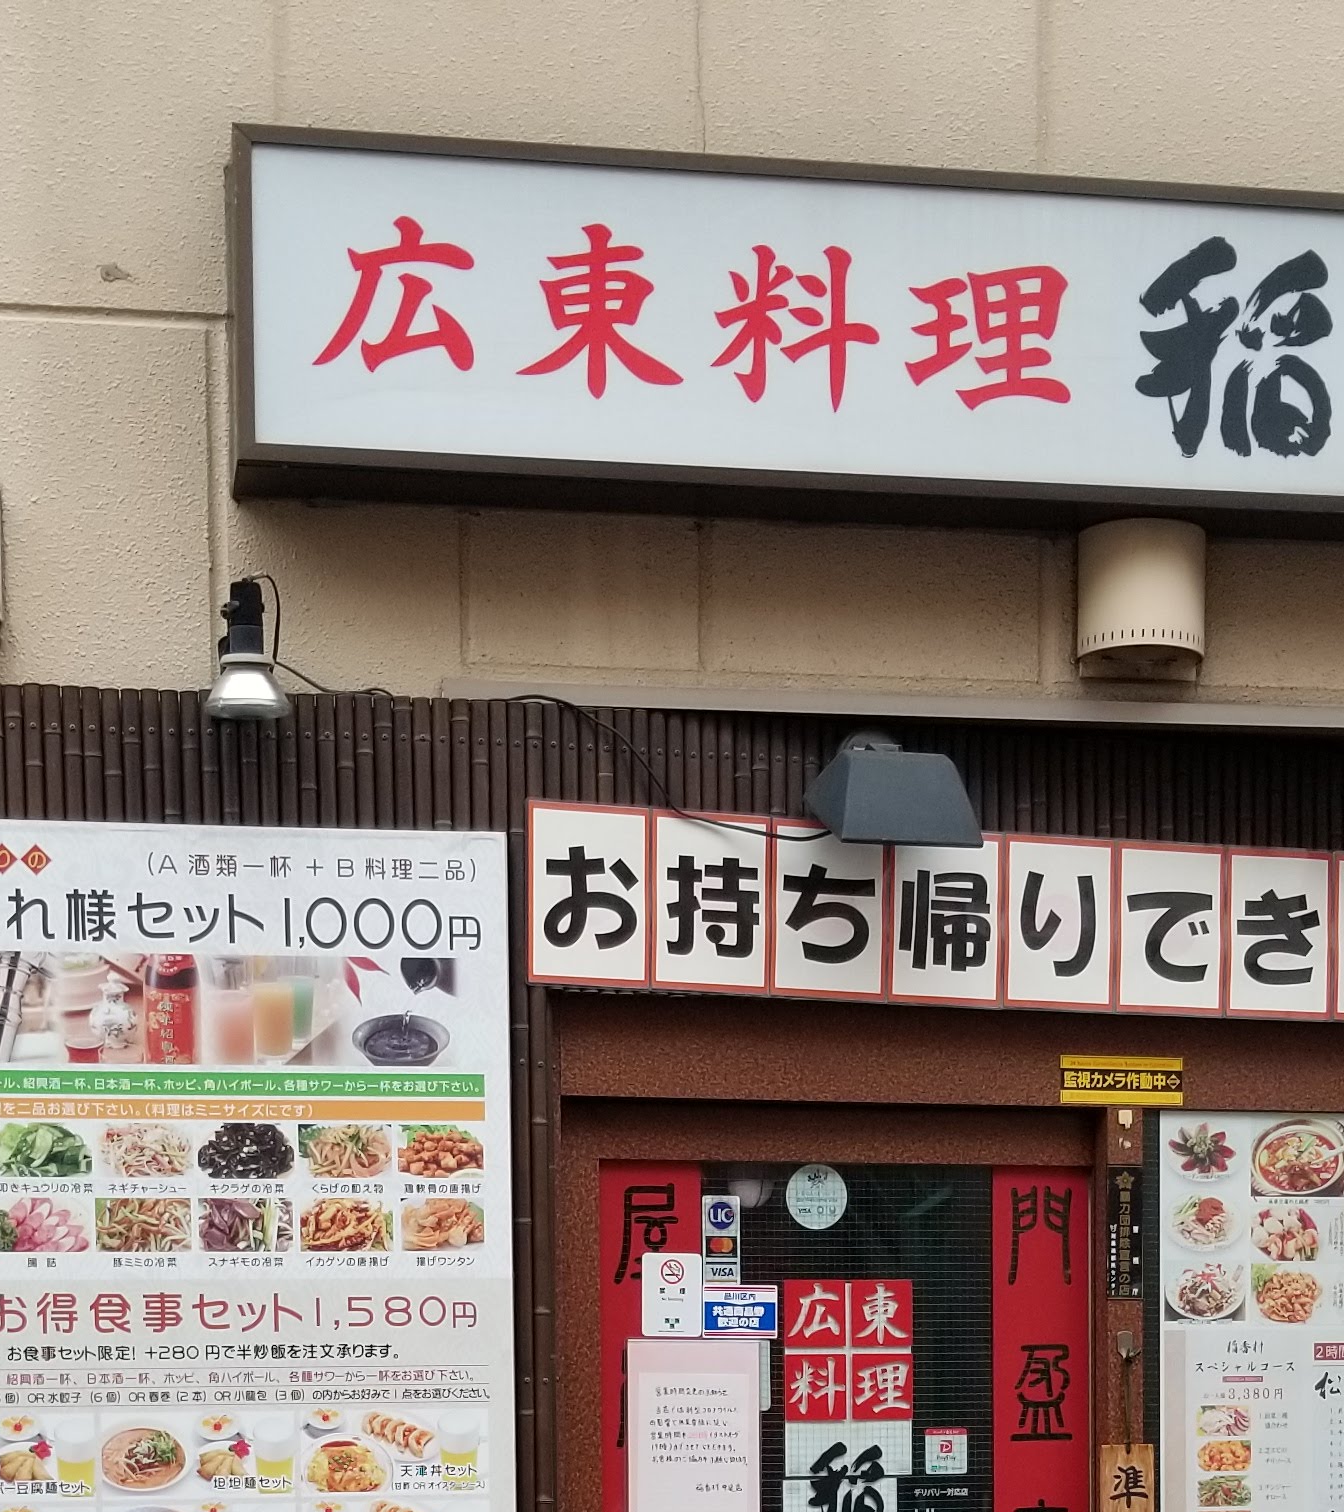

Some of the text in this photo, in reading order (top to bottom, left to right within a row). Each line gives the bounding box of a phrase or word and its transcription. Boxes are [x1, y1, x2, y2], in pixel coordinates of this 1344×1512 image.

[313, 216, 1071, 415] 広東料理
[1063, 1071, 1167, 1090] 監視カメラ作動中
[108, 1183, 187, 1193] ネギチャーシュー
[710, 1267, 735, 1277] VISA
[789, 1284, 908, 1345] 広東
[1194, 1361, 1296, 1373] スペシャルコース
[789, 1356, 910, 1414] 料理
[400, 1464, 478, 1477] 天津丼セット
[913, 1488, 969, 1497] デリバリー対応店
